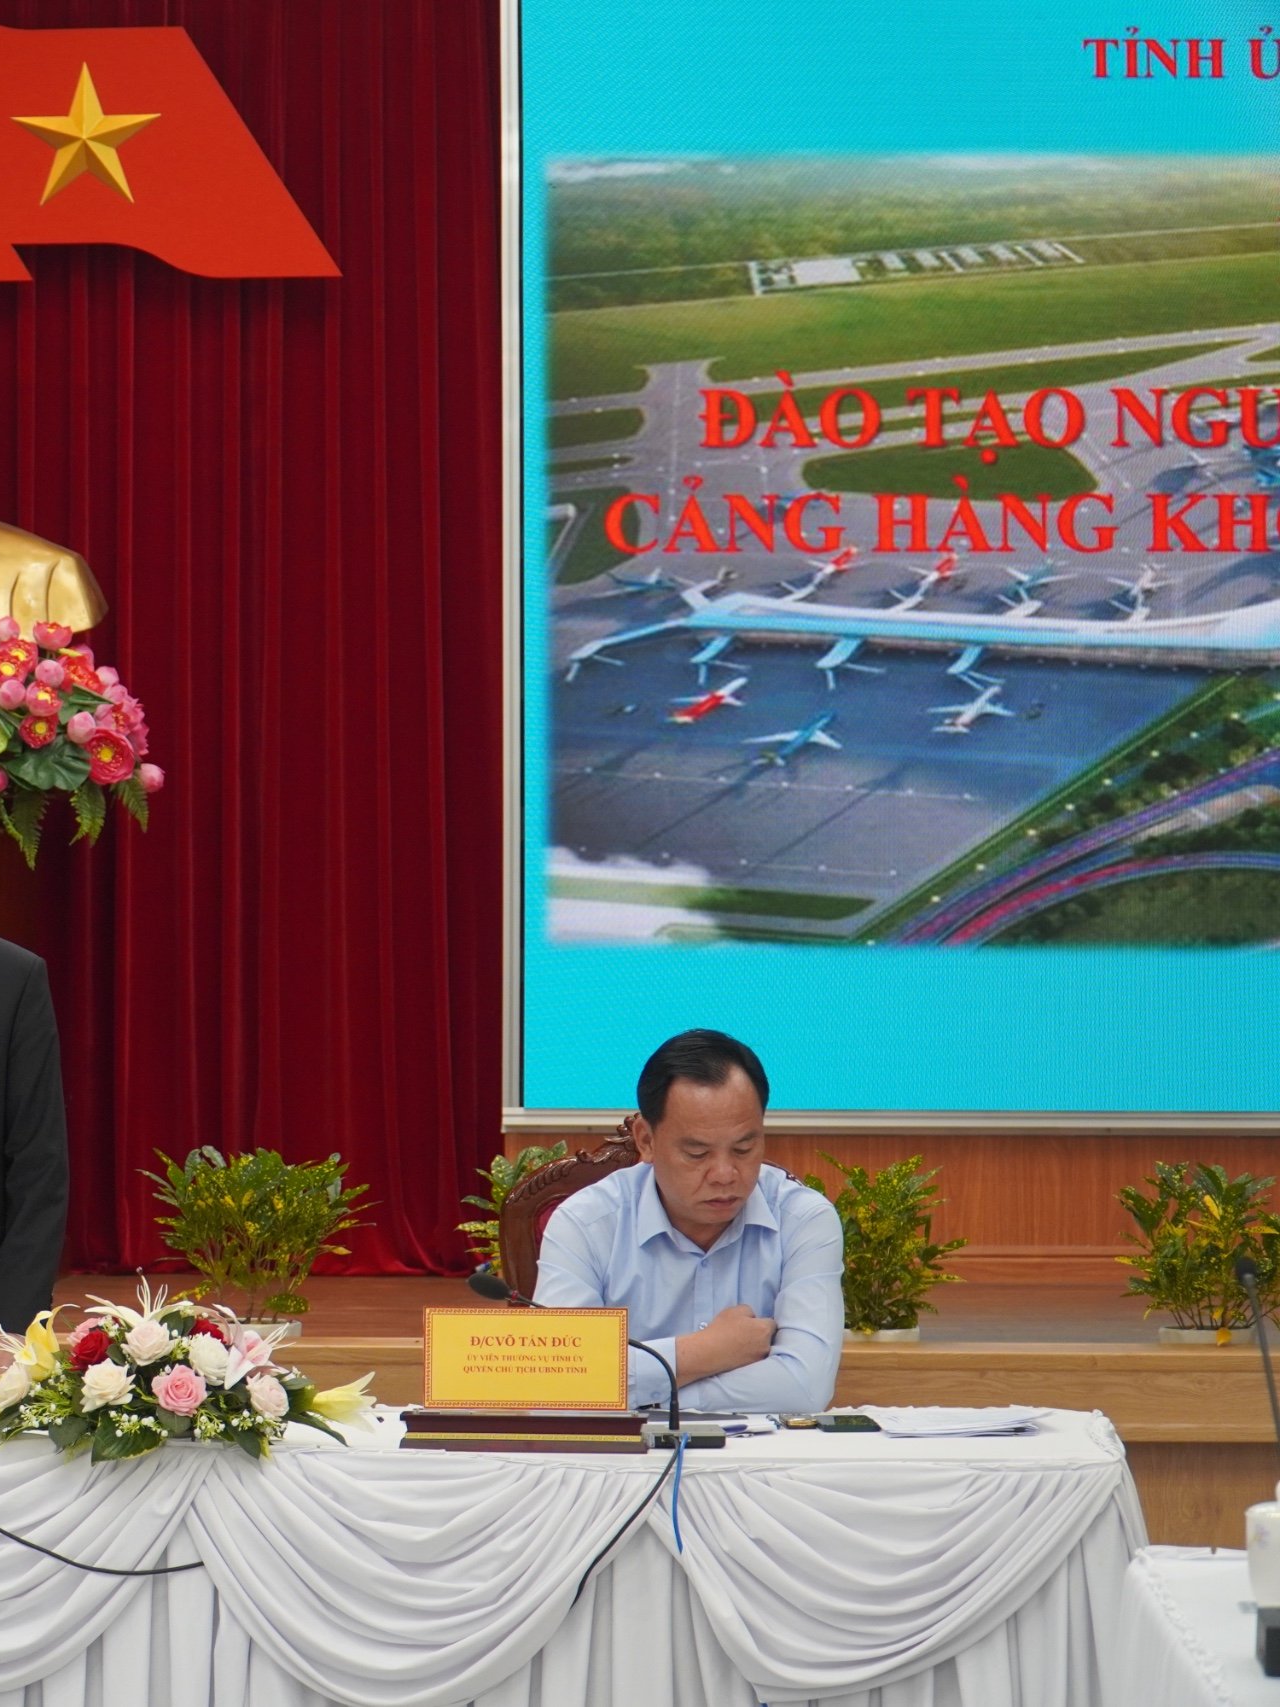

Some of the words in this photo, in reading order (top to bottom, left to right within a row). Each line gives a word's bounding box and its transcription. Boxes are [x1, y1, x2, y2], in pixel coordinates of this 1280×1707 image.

[1082, 26, 1225, 80] TỈNH
[699, 371, 882, 450] ĐÀO
[907, 387, 1085, 466] TẠO
[605, 475, 844, 556] CẢNG
[874, 475, 1119, 556] HÀNG
[1146, 492, 1280, 555] KH
